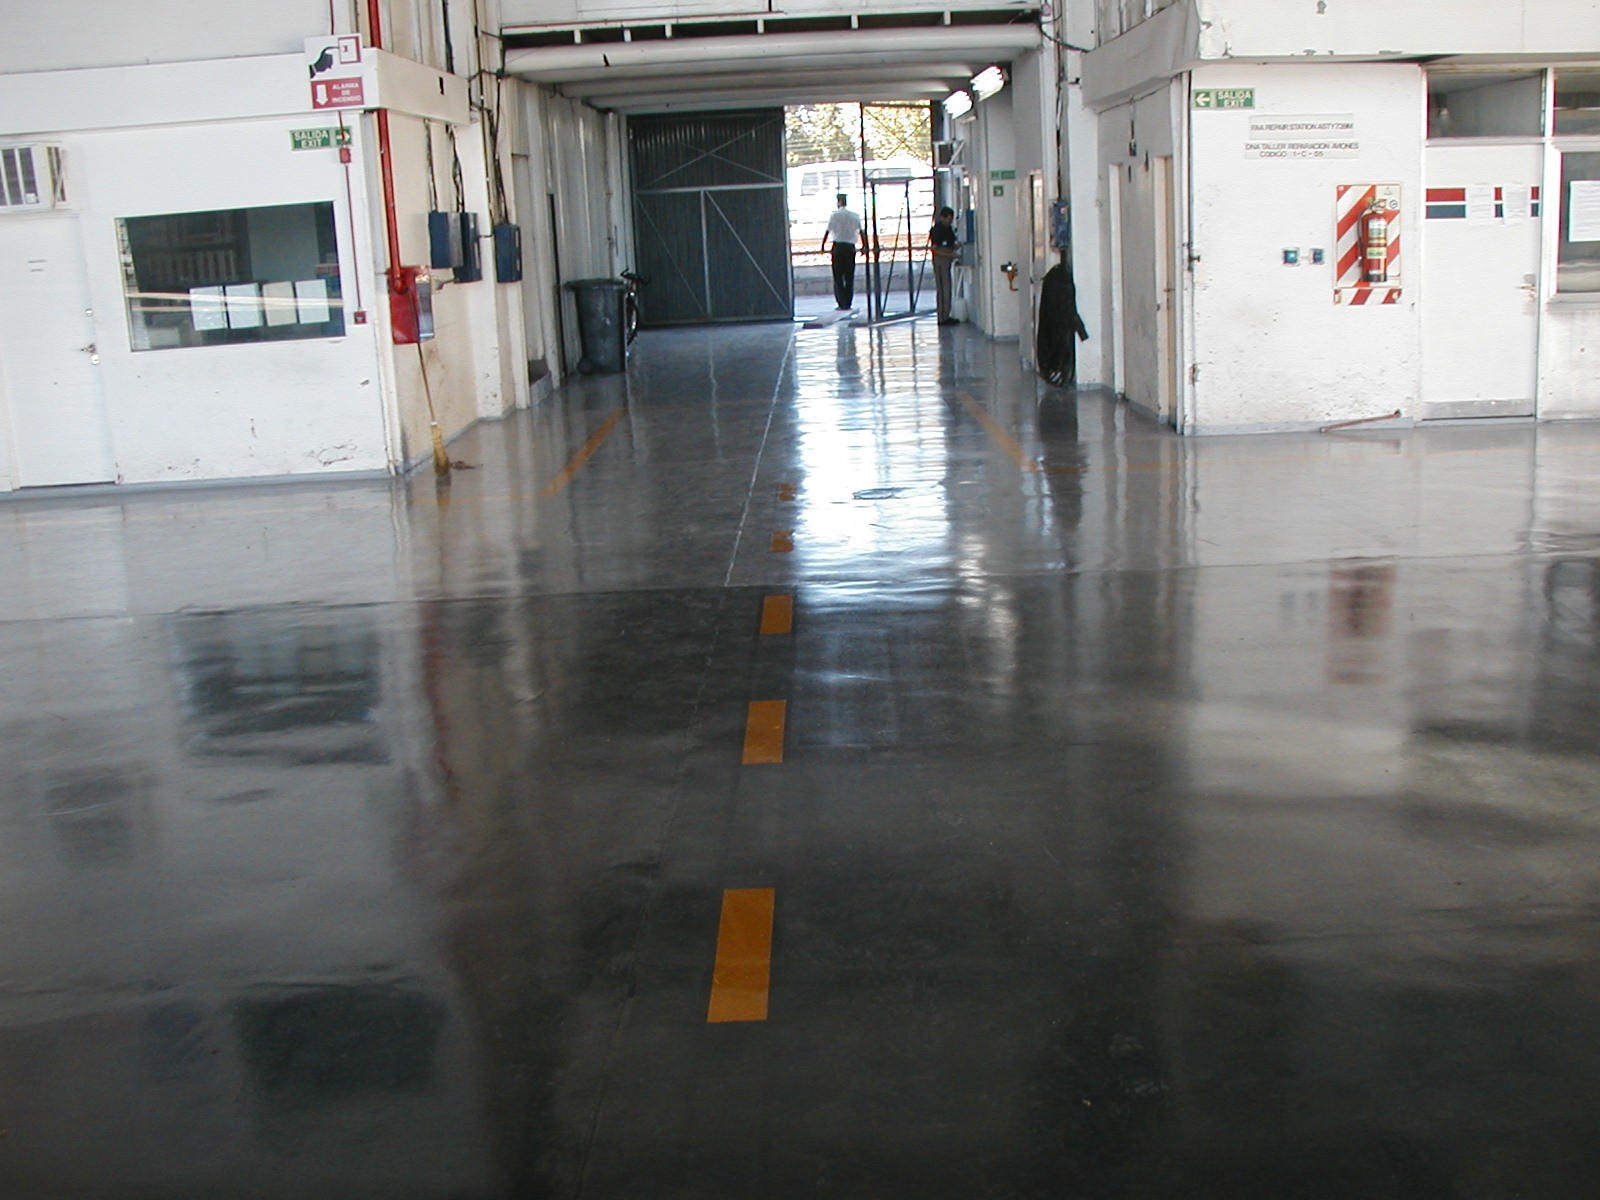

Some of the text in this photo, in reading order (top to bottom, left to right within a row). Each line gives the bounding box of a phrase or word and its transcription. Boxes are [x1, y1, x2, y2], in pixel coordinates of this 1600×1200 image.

[1218, 90, 1252, 99] SALIDA
[1223, 99, 1245, 107] EXIT
[294, 130, 329, 141] SALIDA
[301, 139, 322, 148] EXIT
